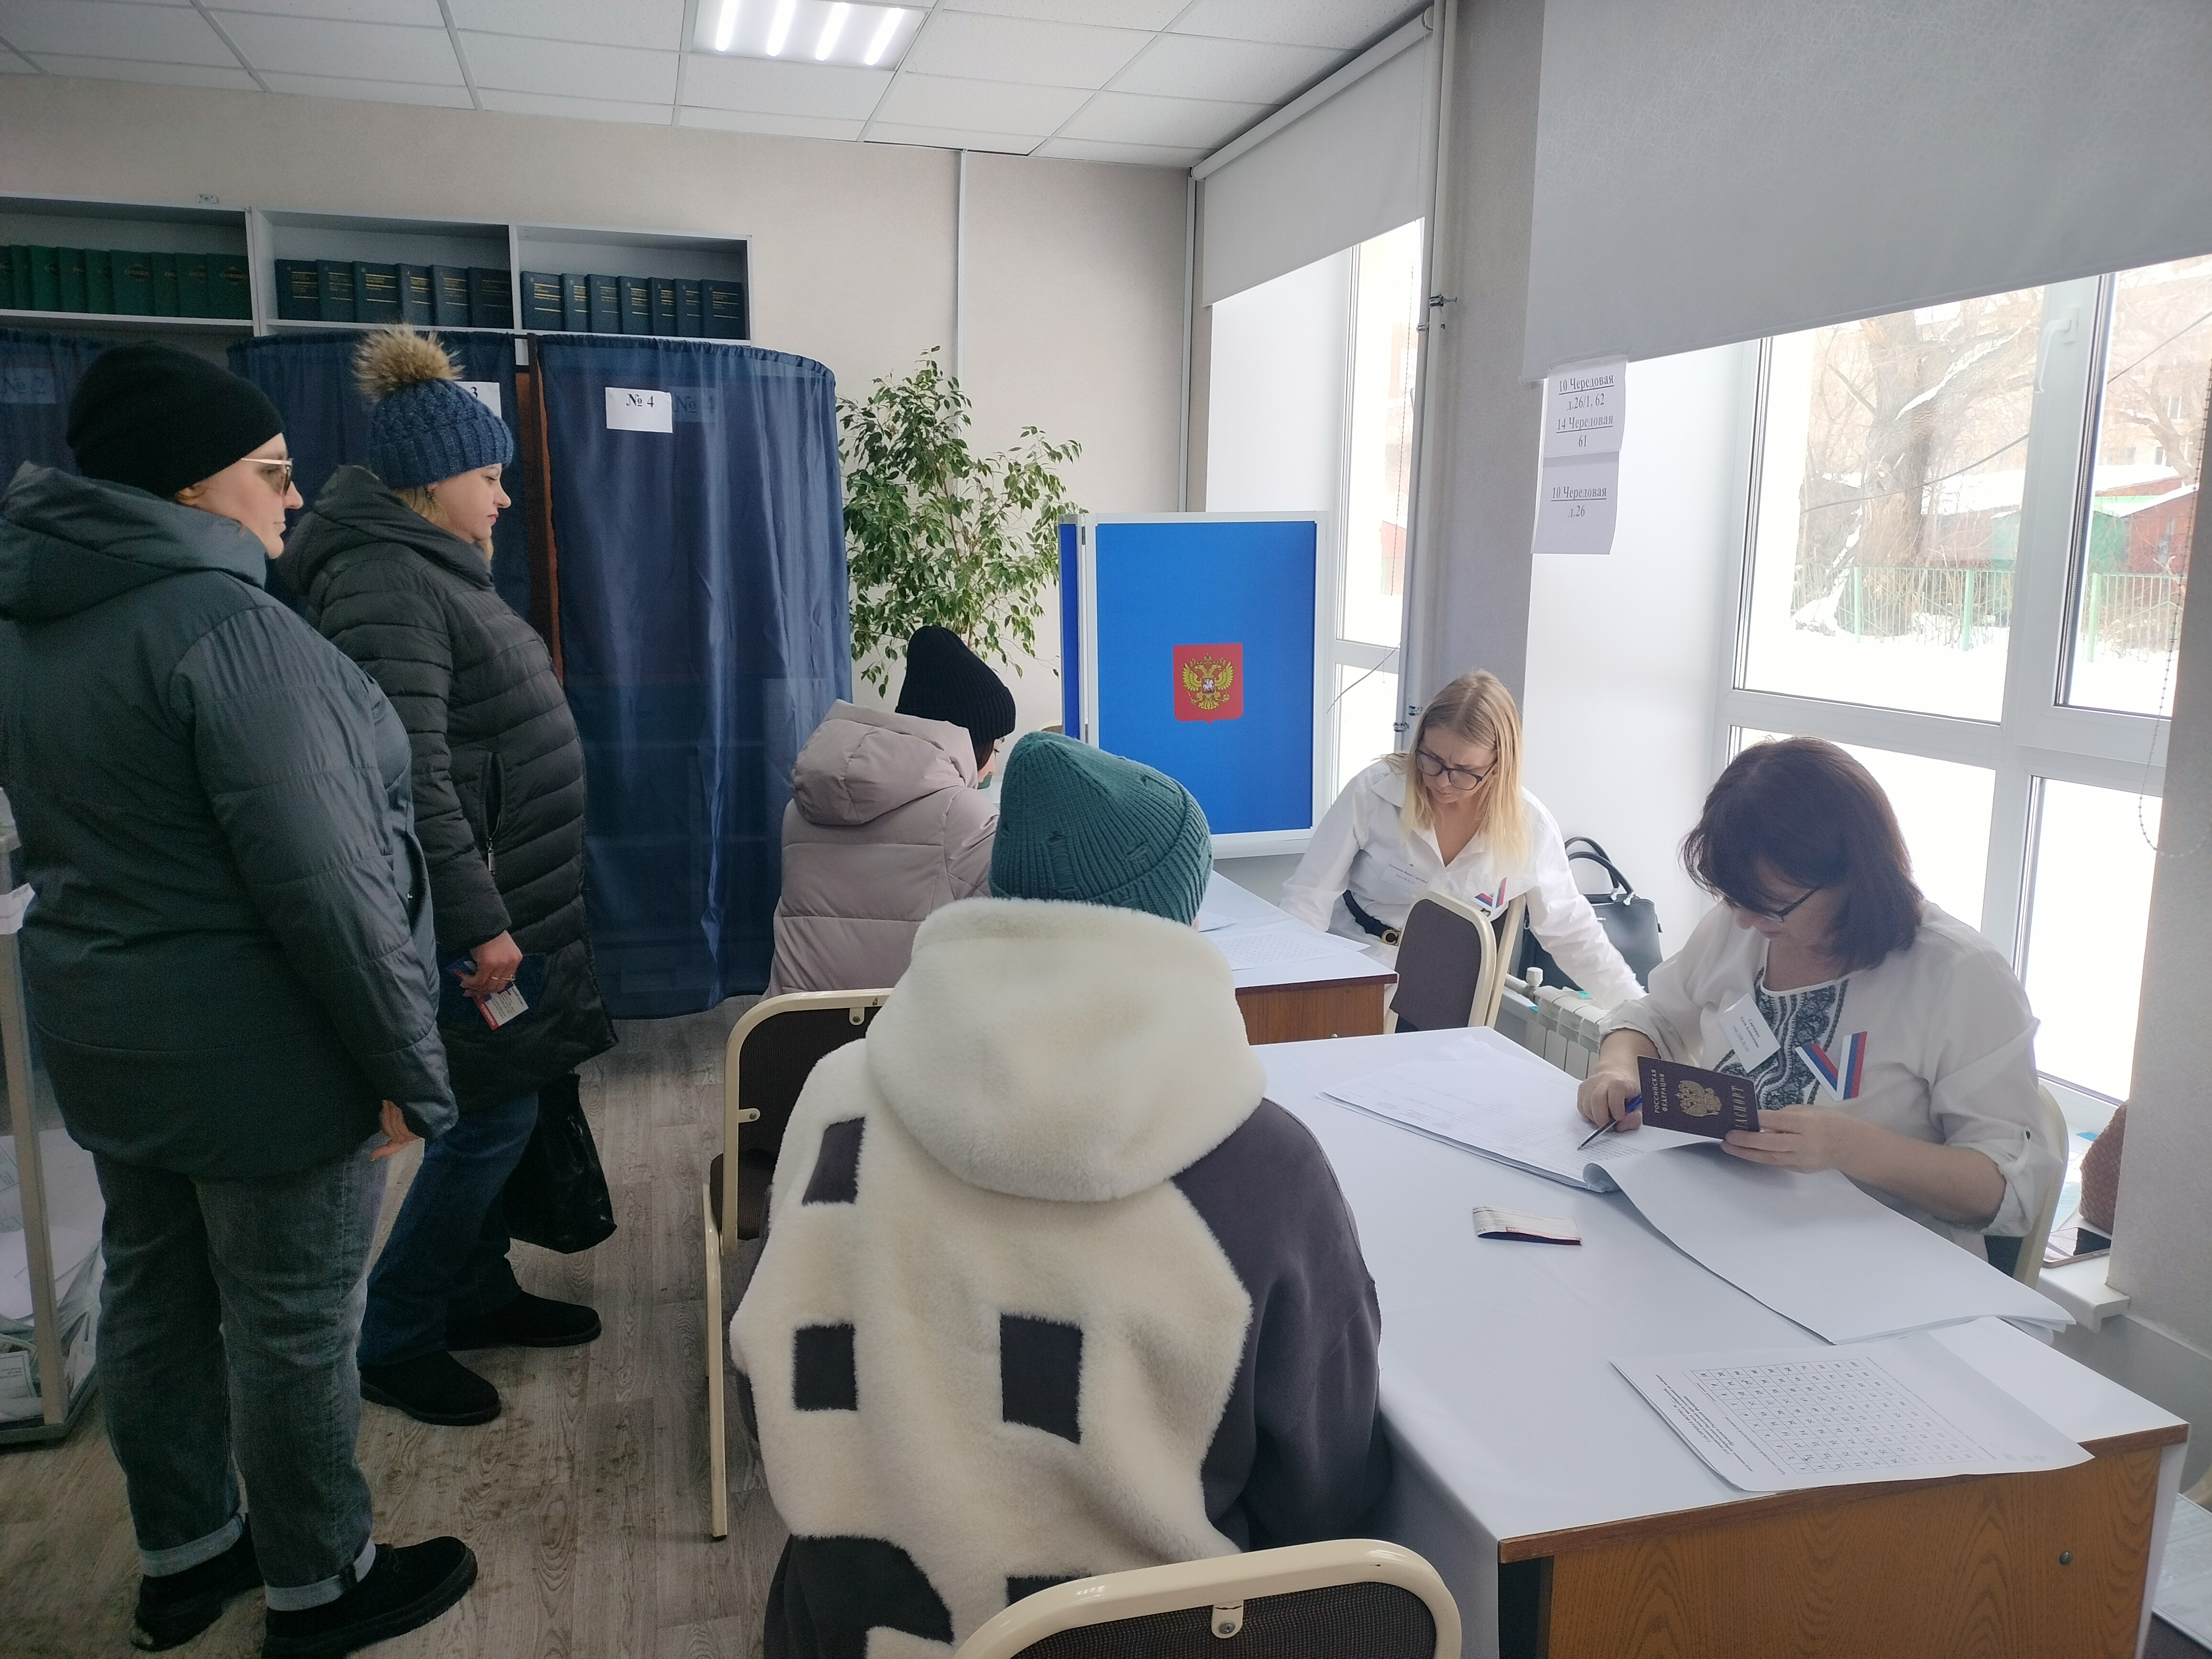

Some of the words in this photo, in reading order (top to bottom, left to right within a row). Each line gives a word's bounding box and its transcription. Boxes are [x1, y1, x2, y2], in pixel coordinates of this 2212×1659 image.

[1559, 379, 1567, 392] 10
[1570, 375, 1614, 391] Чередовая
[626, 393, 642, 407] №
[647, 395, 654, 407] 4
[1595, 393, 1605, 407] 62
[1558, 417, 1566, 431] 14
[1569, 415, 1614, 430] Чередовая
[1579, 435, 1587, 448] 61
[1552, 487, 1561, 498] 10
[1563, 486, 1607, 500] Чередовая
[1568, 505, 1586, 518] д.26
[1651, 1069, 1659, 1114] РОССИЙСКАЯ
[1659, 1073, 1668, 1112] ФЕДЕРАЦИЯ
